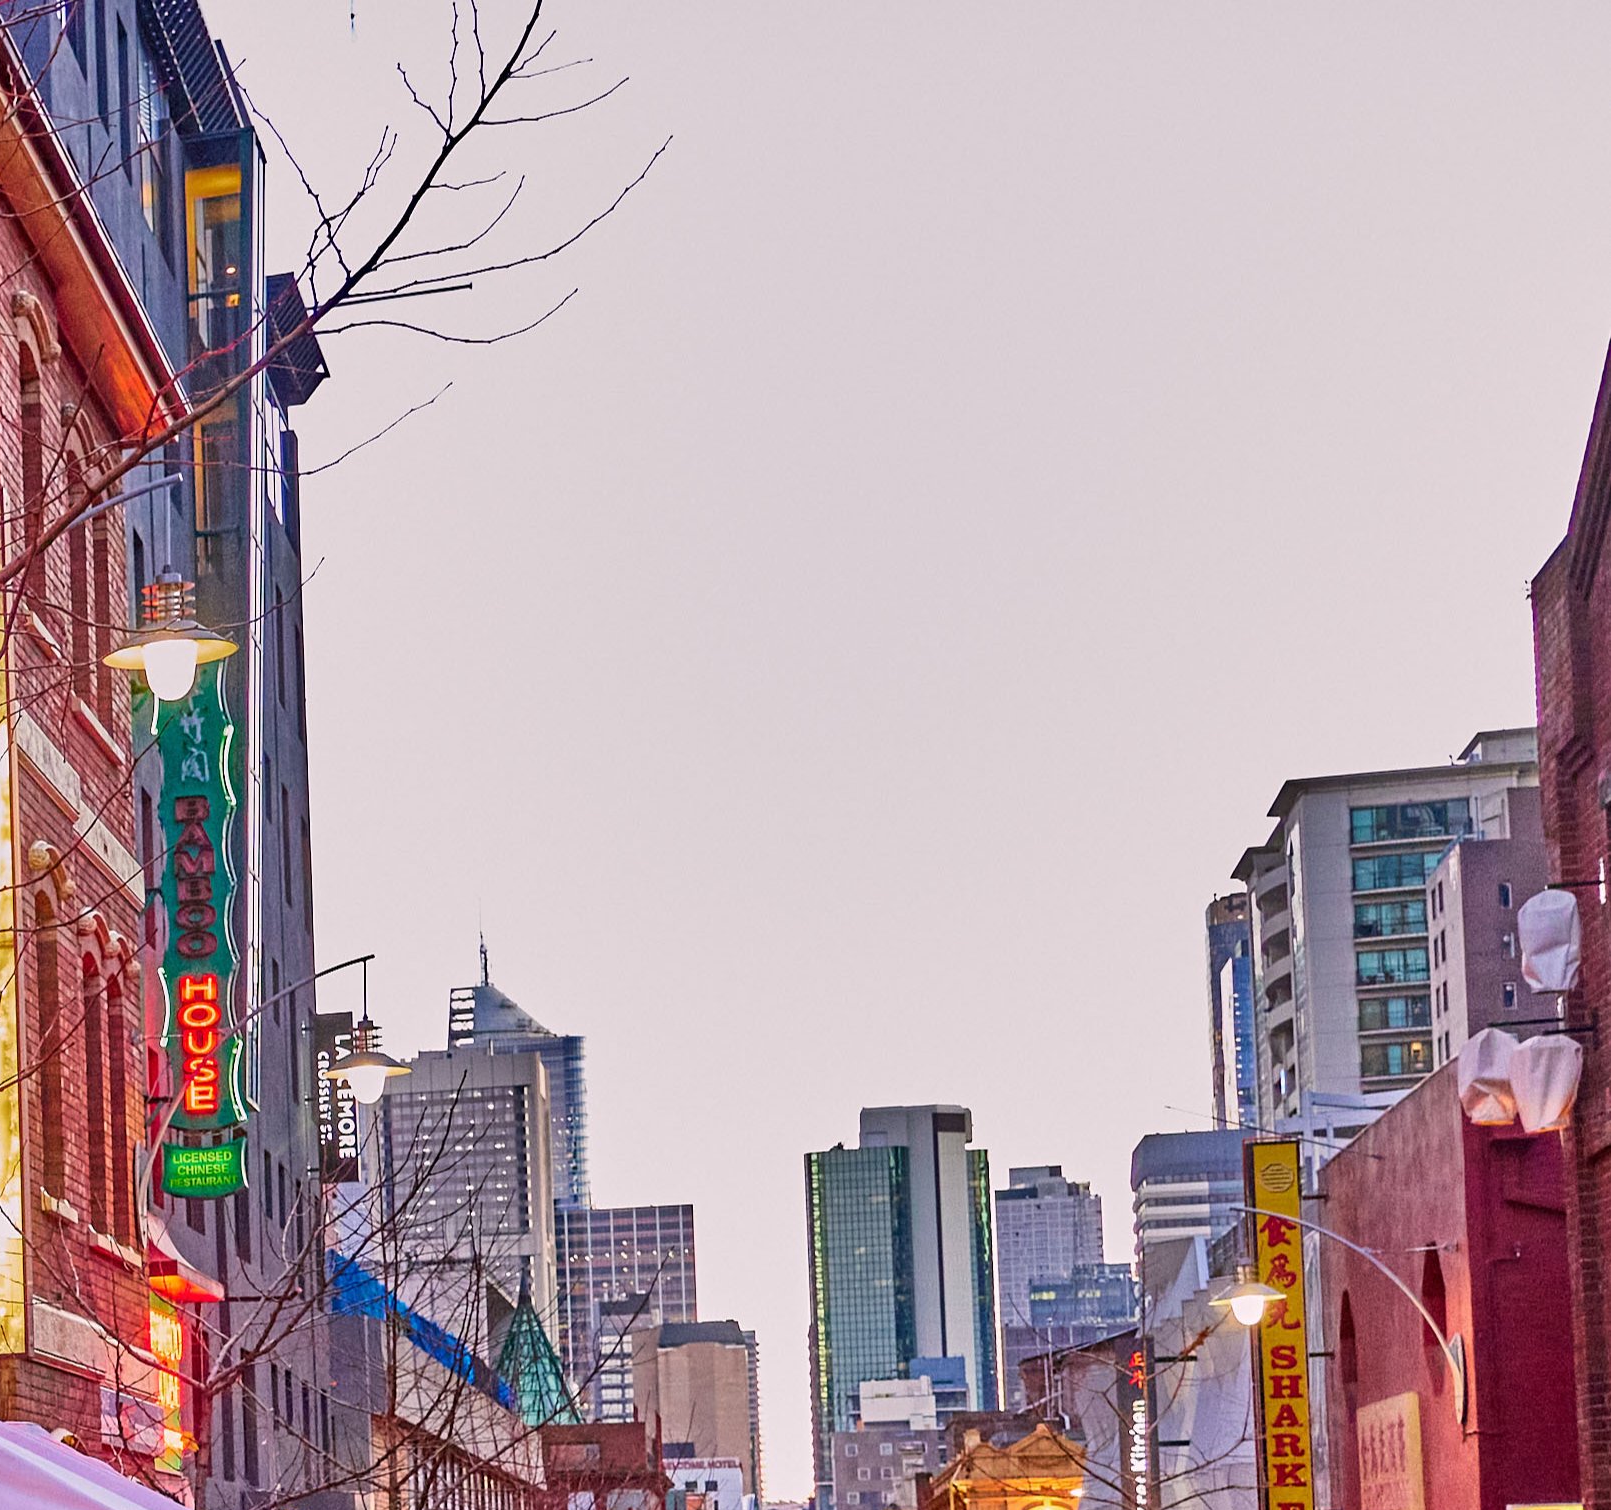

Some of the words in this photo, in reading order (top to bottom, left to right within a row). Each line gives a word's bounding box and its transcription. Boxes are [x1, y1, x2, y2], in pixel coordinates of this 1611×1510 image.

[173, 795, 219, 960] BAMBOO
[177, 973, 222, 1115] HOUSE
[317, 1051, 332, 1120] CROSSLEY
[334, 1034, 357, 1159] LACEMORE
[170, 1175, 238, 1188] RESTAURANT
[171, 1150, 233, 1164] LICENSED
[177, 1163, 230, 1176] CHINESE
[1268, 1344, 1308, 1488] SHARK
